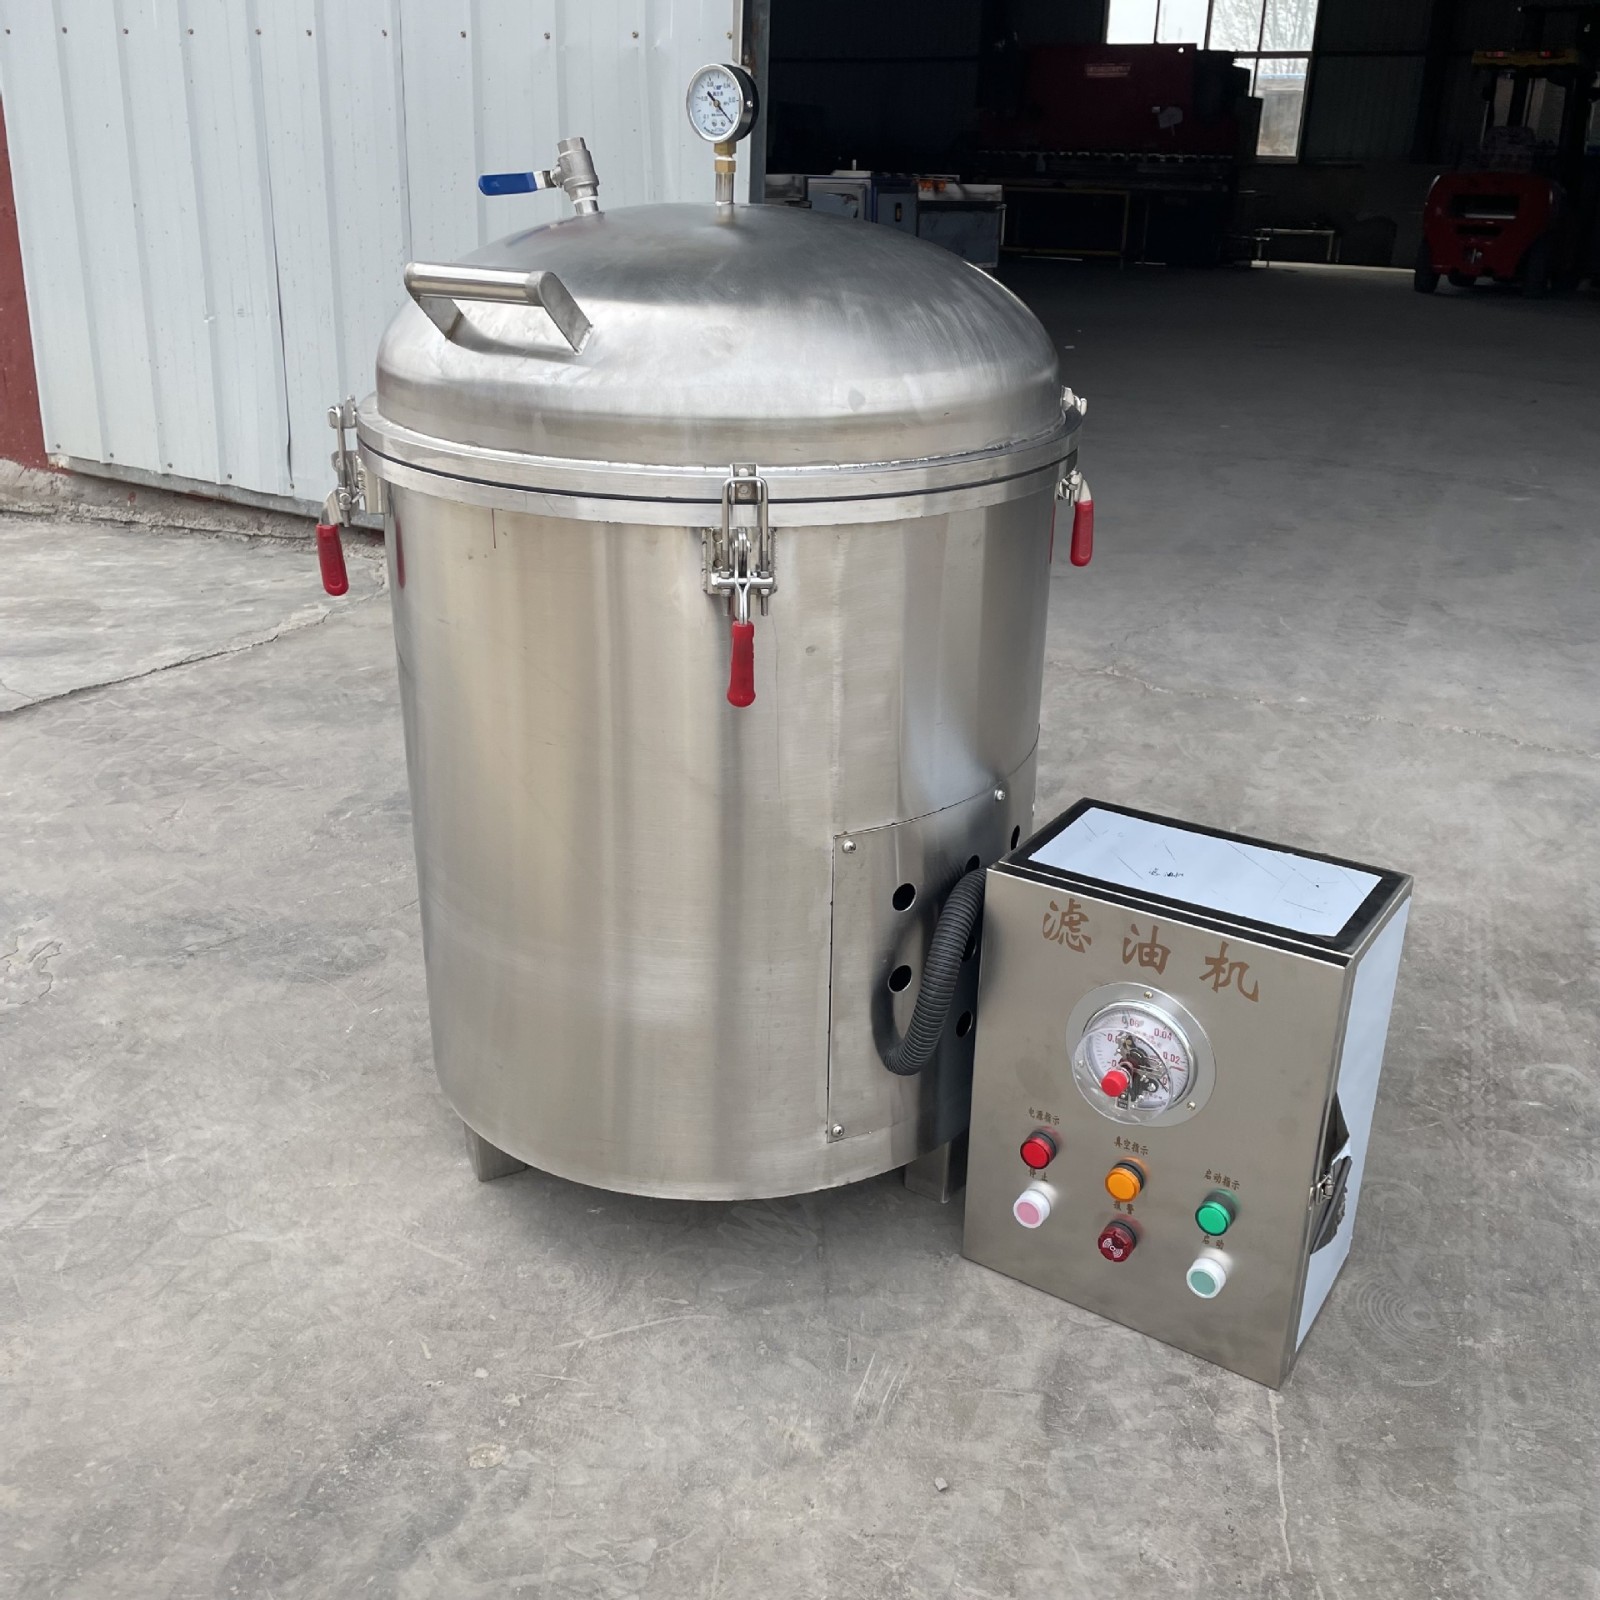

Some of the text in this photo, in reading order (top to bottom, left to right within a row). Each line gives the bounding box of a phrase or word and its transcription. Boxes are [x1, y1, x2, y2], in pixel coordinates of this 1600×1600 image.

[1042, 898, 1259, 1003] 滤油机
[1121, 1015, 1140, 1028] 0.06
[1153, 1028, 1173, 1041] 0.04
[1162, 1051, 1181, 1065] 0.02
[1114, 1136, 1149, 1155] 真空指示
[1204, 1169, 1240, 1191] 启动指示
[1202, 1234, 1225, 1250] 启动
